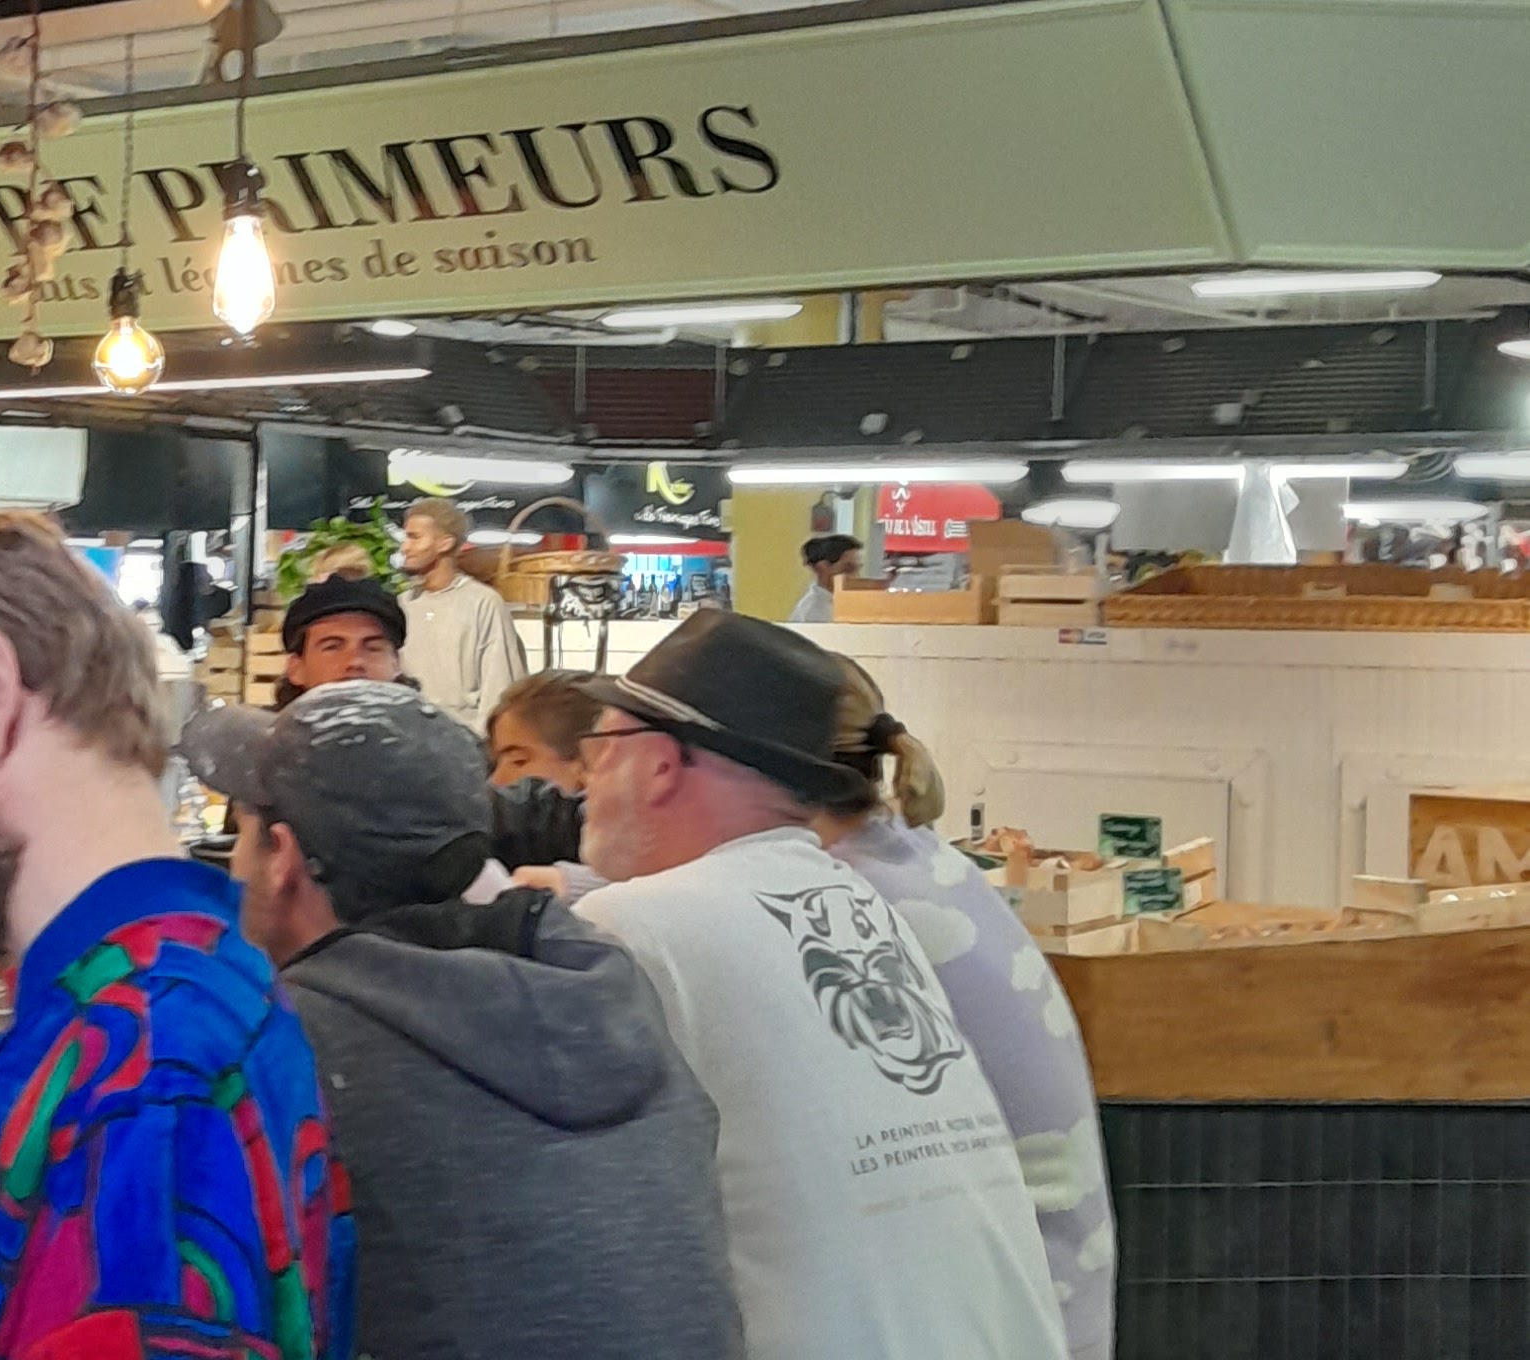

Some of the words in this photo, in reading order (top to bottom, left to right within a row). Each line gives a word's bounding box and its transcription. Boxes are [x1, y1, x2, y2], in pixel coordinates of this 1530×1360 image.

[364, 240, 416, 279] de
[433, 230, 598, 274] saison
[855, 1134, 877, 1150] LA
[850, 1157, 879, 1176] LES
